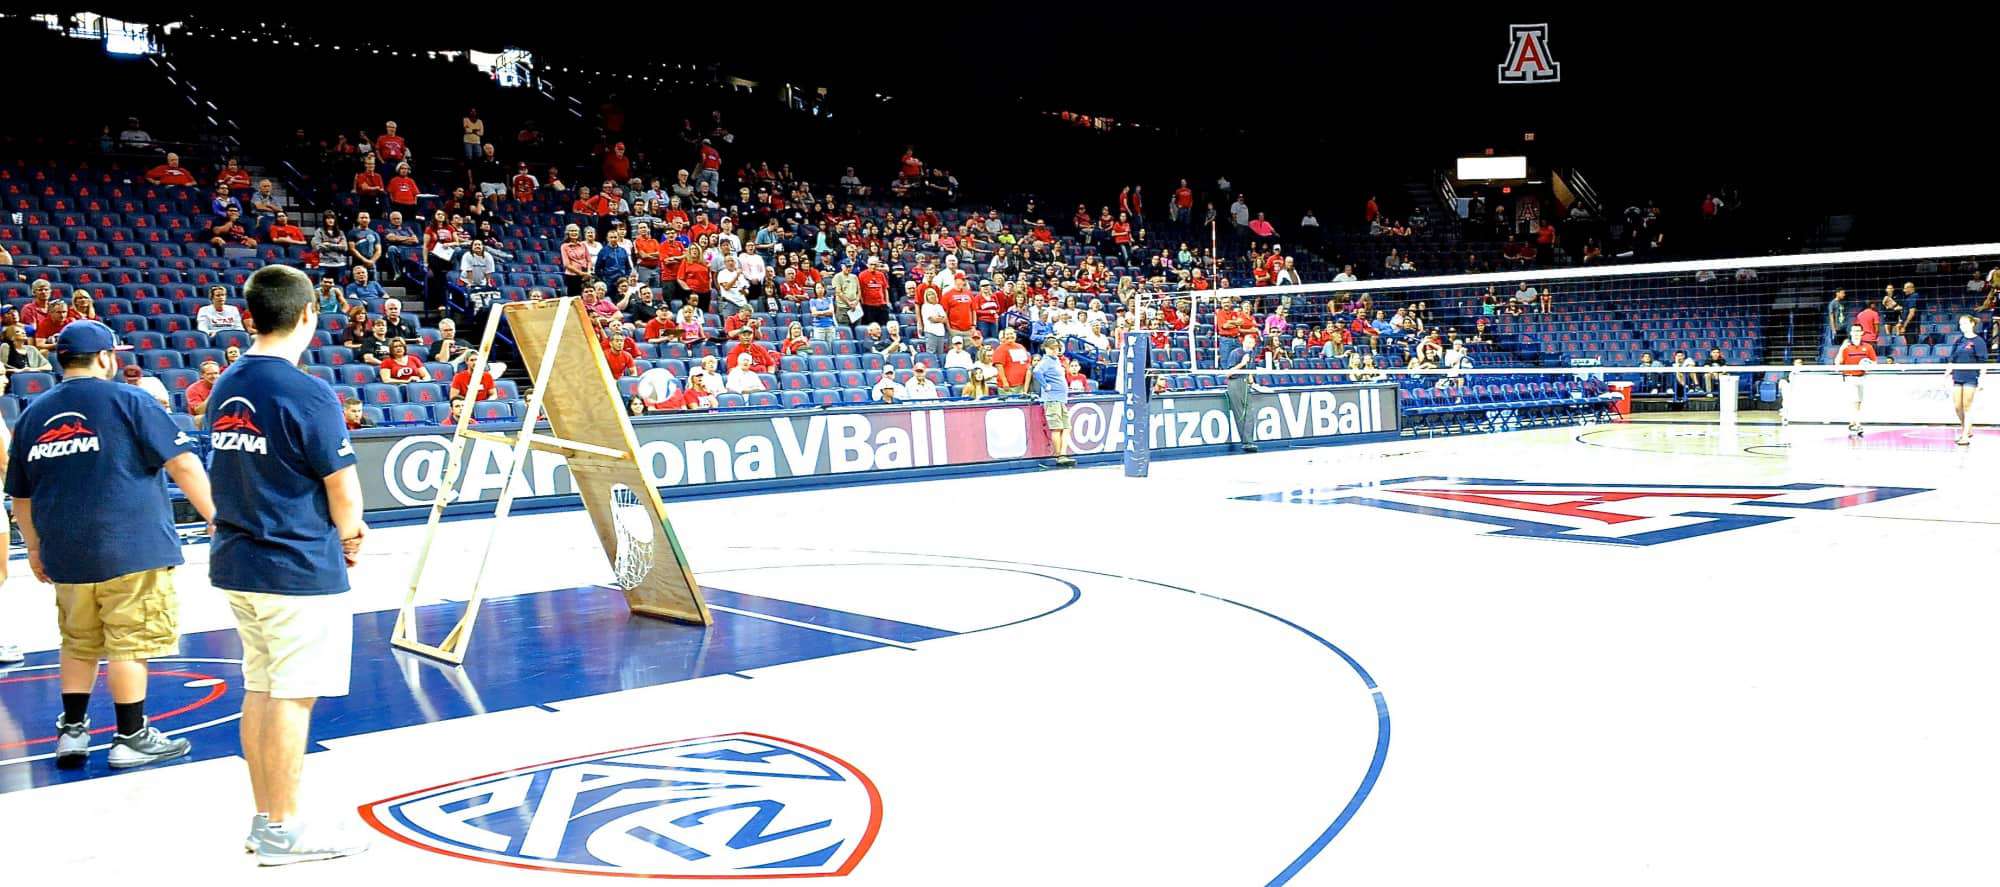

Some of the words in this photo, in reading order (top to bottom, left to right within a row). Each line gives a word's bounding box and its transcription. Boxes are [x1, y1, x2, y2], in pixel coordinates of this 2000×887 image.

[1498, 23, 1560, 84] A
[1126, 346, 1136, 451] ARIZONA
[27, 436, 100, 462] ARIZONA
[383, 408, 945, 507] @AronaVBall
